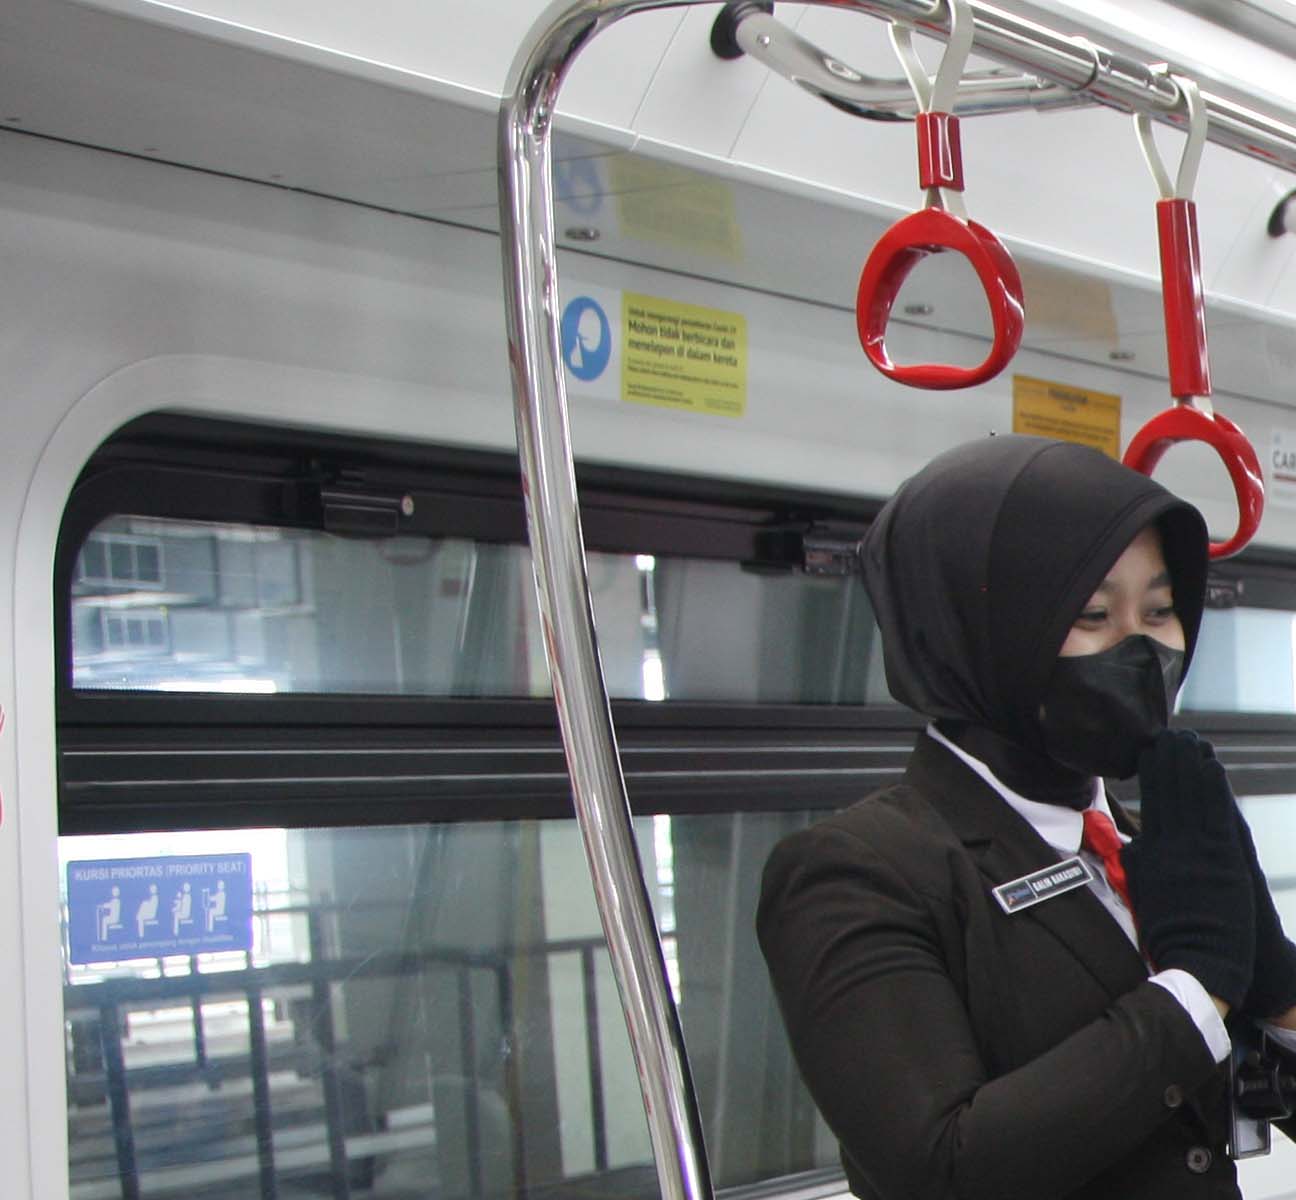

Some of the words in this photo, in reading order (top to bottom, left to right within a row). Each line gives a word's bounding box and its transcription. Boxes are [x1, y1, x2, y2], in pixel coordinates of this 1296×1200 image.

[628, 319, 658, 336] Mohon
[659, 323, 680, 339] tidak
[682, 328, 719, 347] berbicara
[720, 335, 736, 350] dan
[75, 866, 111, 881] KURSI
